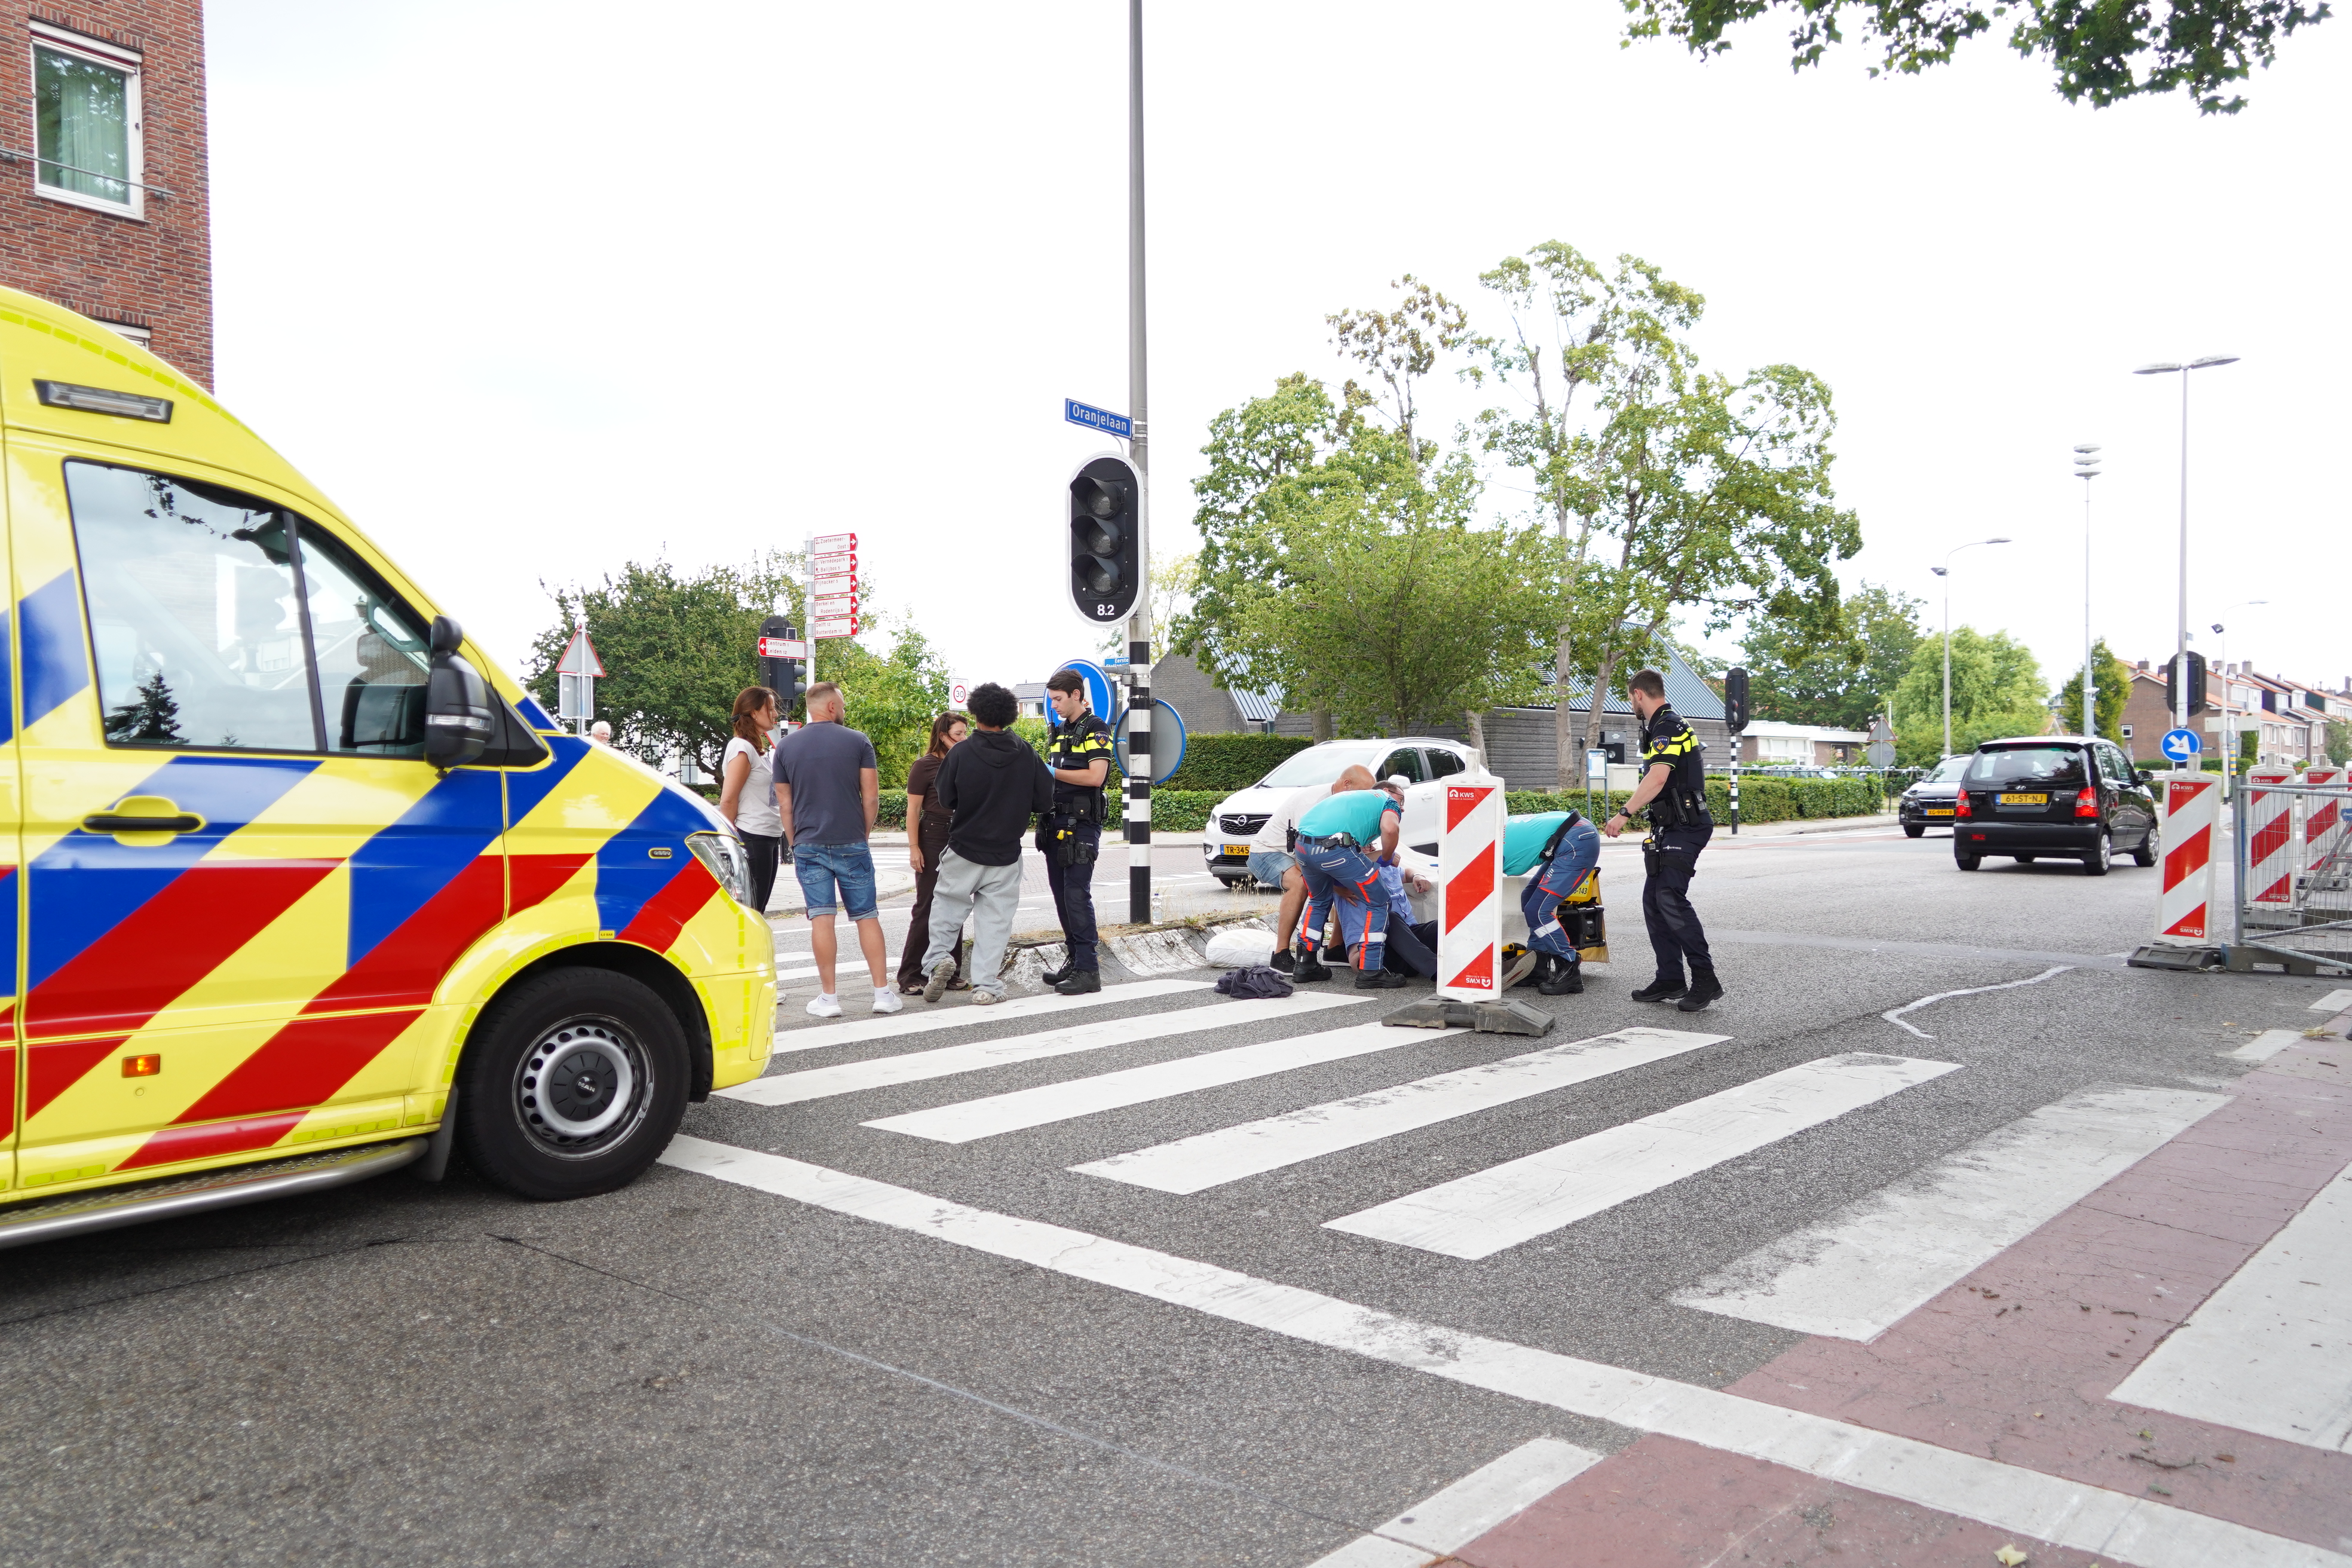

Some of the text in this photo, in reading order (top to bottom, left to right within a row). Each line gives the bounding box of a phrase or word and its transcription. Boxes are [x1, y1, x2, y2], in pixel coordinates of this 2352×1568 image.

[1073, 404, 1126, 431] Oranjelaan
[1097, 604, 1114, 615] 8.2
[577, 1081, 595, 1092] MAN
